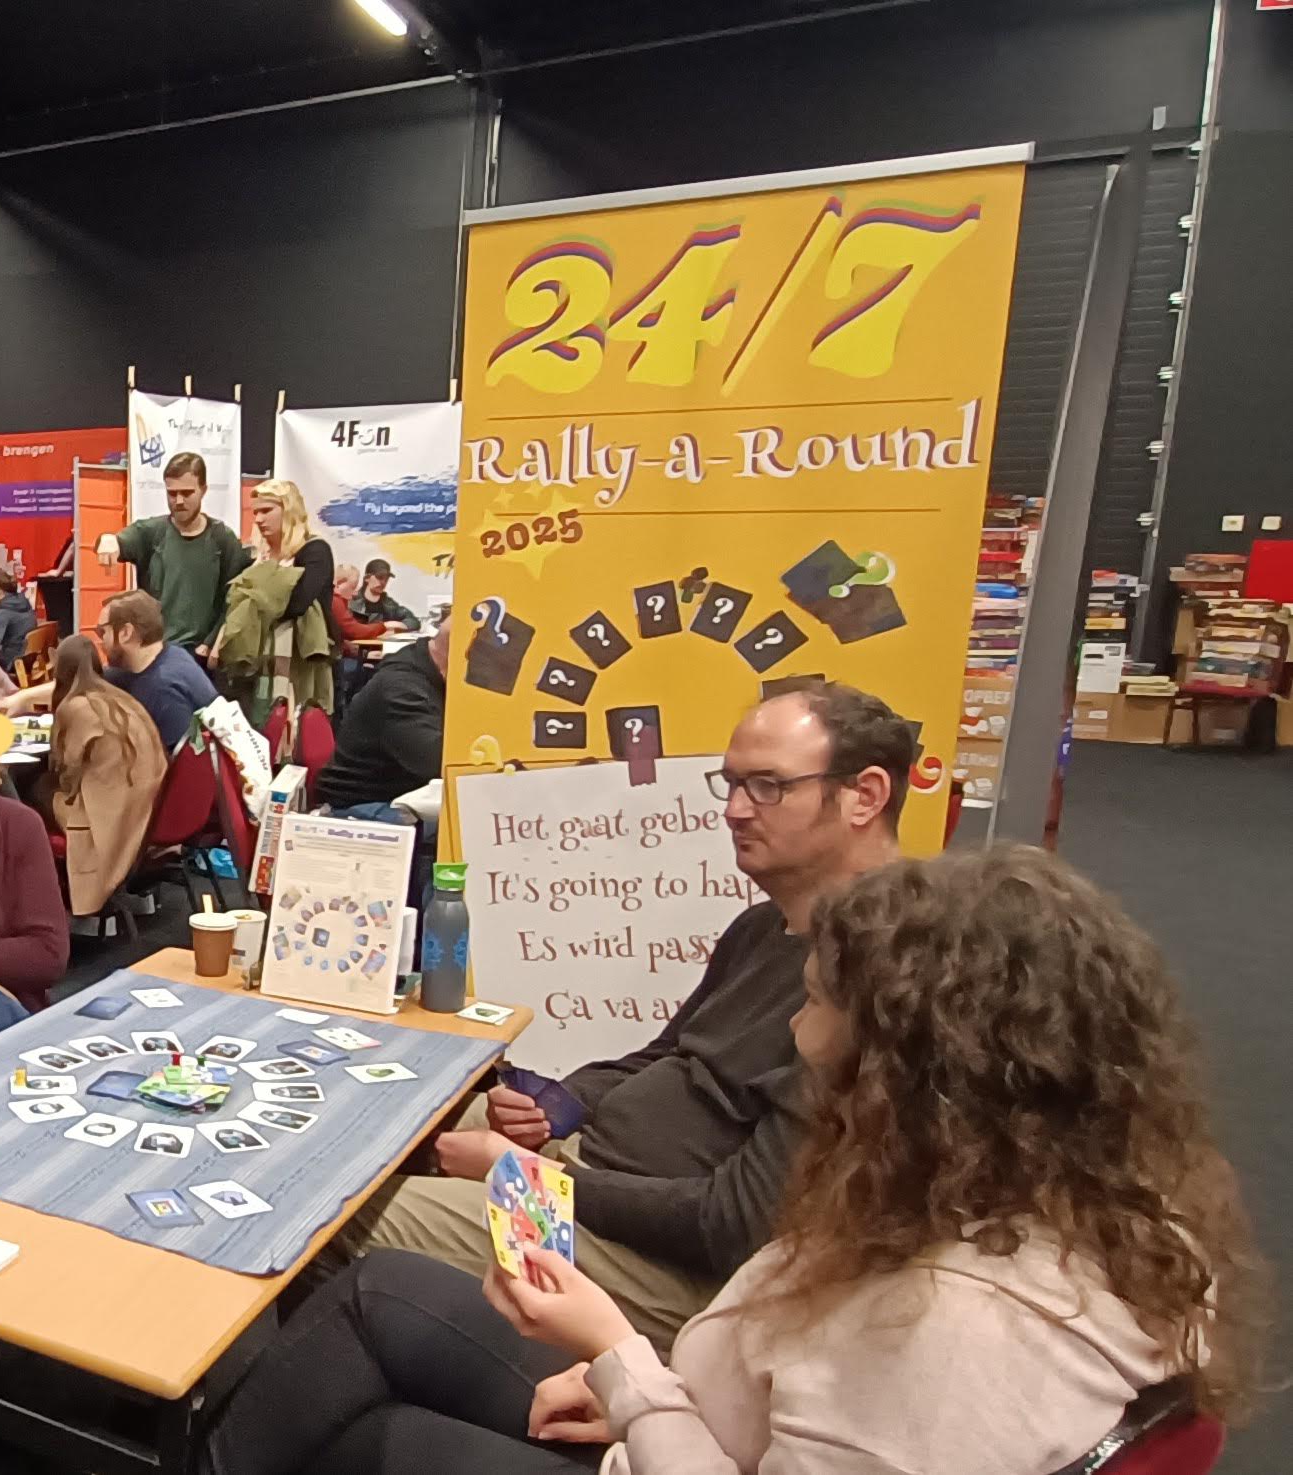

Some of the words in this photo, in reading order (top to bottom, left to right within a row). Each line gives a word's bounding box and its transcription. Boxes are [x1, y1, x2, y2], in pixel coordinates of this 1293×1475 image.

[485, 195, 981, 397] 24/7
[463, 397, 982, 508] Rally-a-Round
[364, 502, 381, 515] Fly
[382, 502, 423, 516] beyond
[424, 502, 445, 514] the
[480, 508, 583, 558] 2025
[491, 812, 550, 846] Het
[558, 809, 630, 852] gaat
[639, 793, 727, 849] gebe
[486, 871, 541, 905] It's
[548, 870, 643, 913] going
[654, 870, 688, 900] to
[516, 930, 558, 962] Es
[567, 925, 636, 959] wird
[544, 989, 594, 1030] Ça
[602, 996, 644, 1023] va
